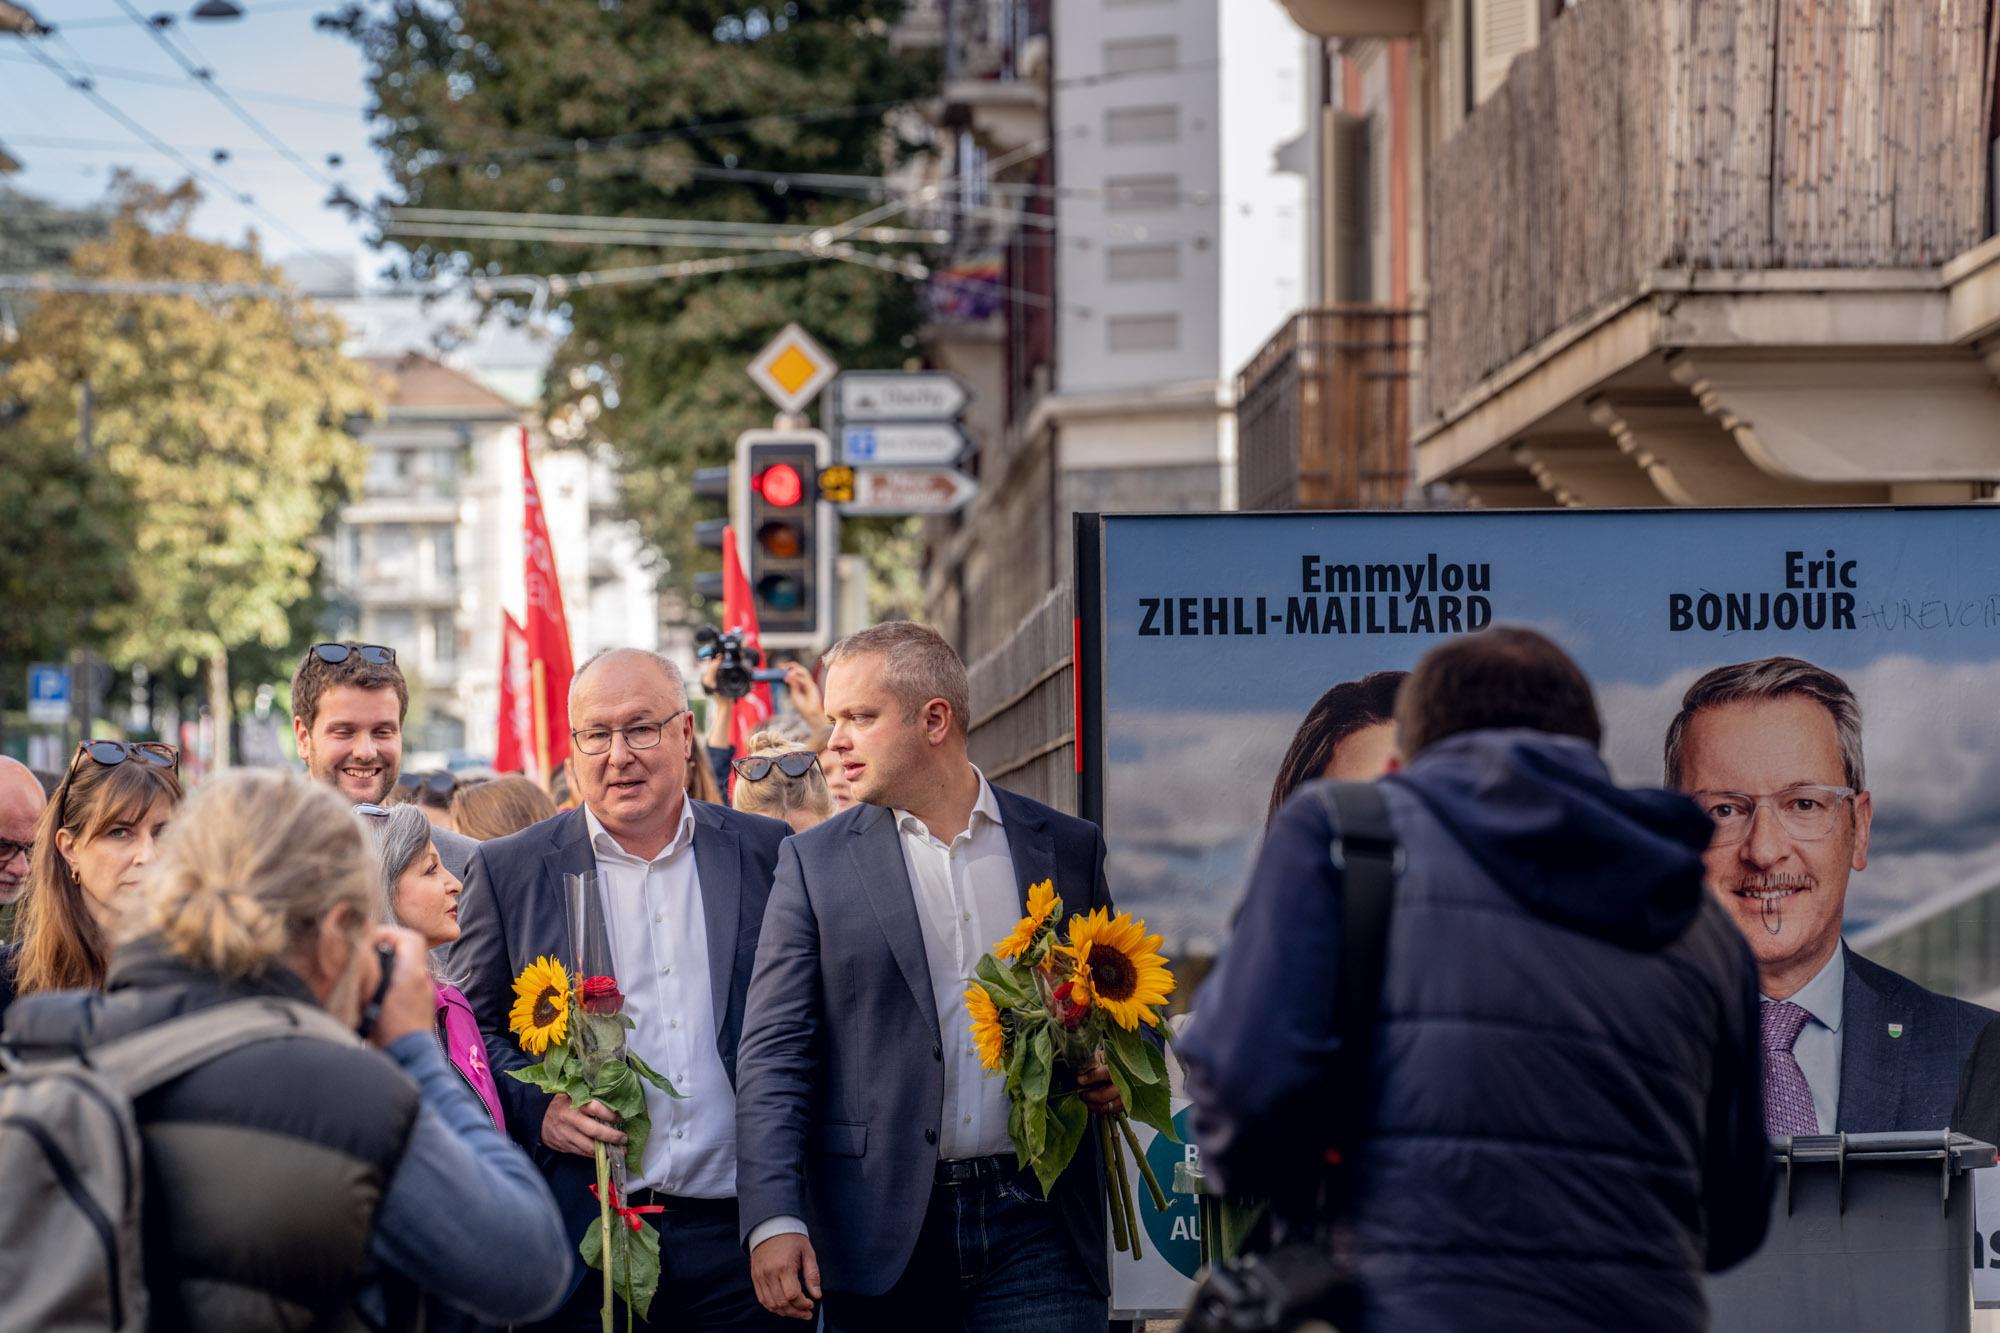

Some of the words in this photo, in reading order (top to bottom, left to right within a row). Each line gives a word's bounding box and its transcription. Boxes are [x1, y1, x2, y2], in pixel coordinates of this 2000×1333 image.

[1302, 553, 1491, 603] Emmylou
[1785, 550, 1857, 589] Eric
[1138, 596, 1492, 636] ZIEHLI-MAILLARD
[1669, 592, 1857, 631] BONJOUR
